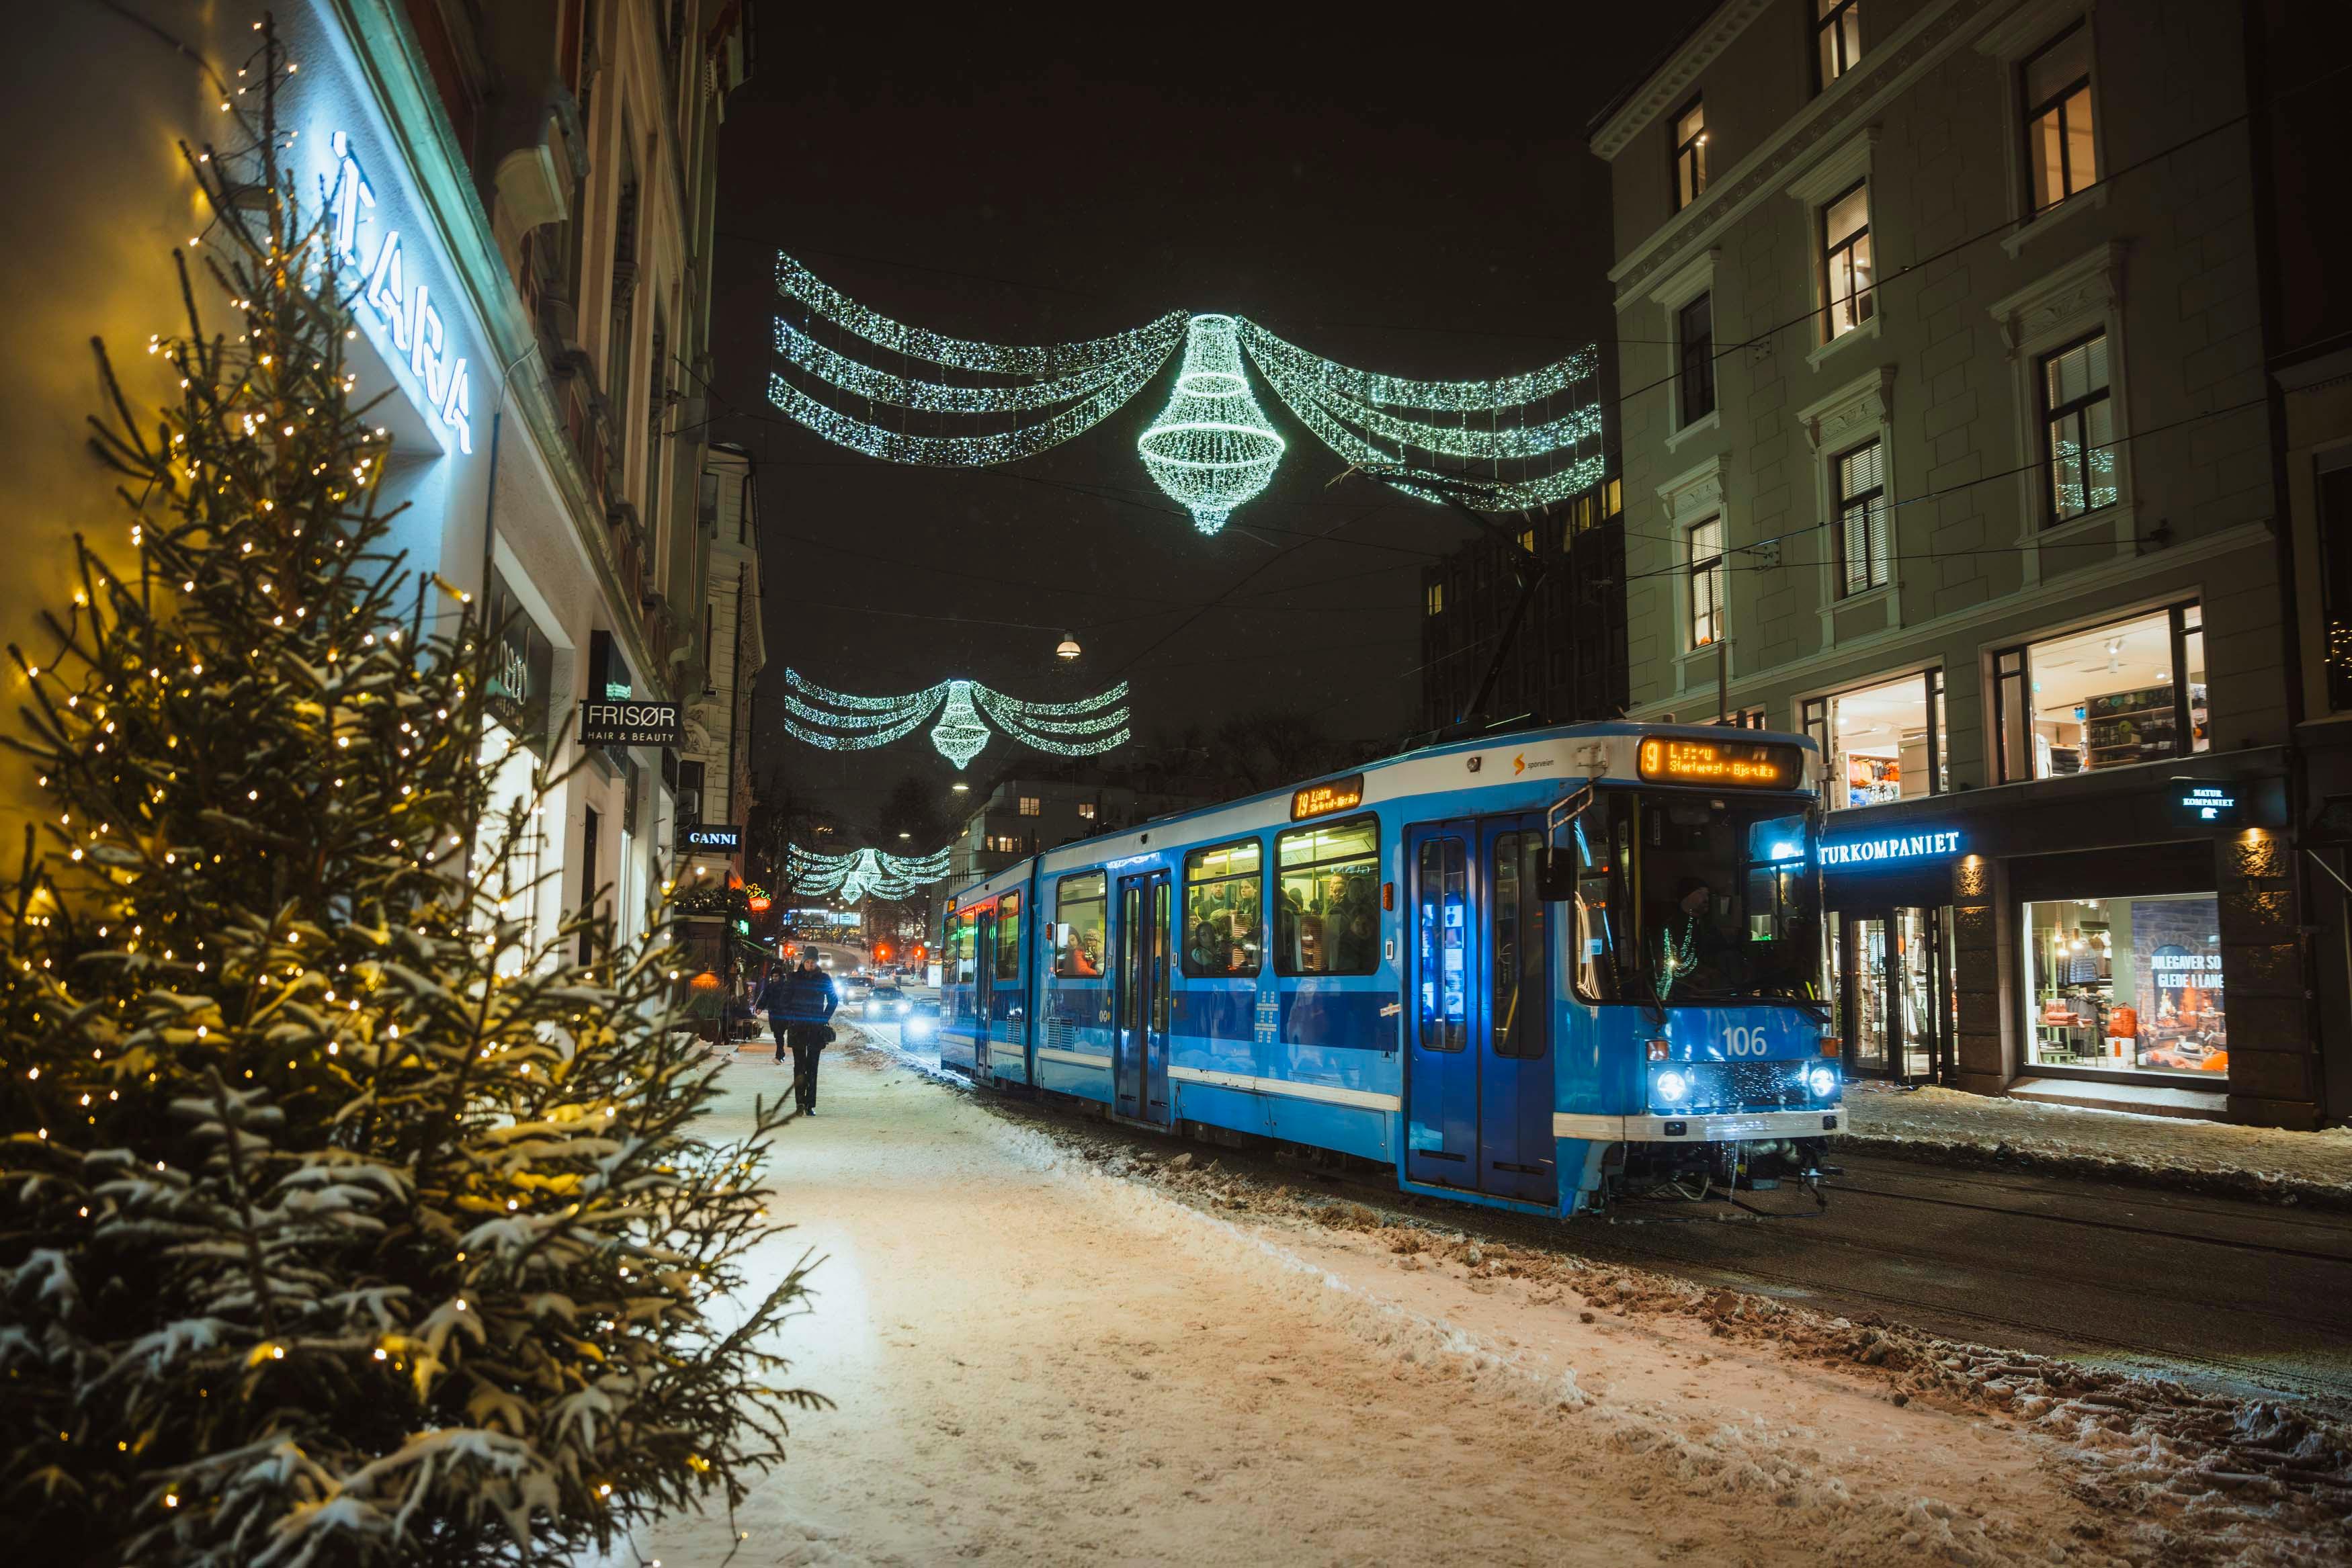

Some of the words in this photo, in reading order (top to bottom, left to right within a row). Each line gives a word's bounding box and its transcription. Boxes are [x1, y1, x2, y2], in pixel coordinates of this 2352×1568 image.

[589, 705, 675, 727] FRISØR
[587, 732, 614, 740] HAIR
[620, 732, 626, 740] &
[632, 733, 674, 742] BEAUTY
[2193, 789, 2223, 797] NATUR
[1296, 793, 1309, 817] 19
[2183, 798, 2234, 807] KOMPANIET
[689, 833, 737, 845] GANNI
[2150, 955, 2205, 969] JULEGAVER
[2158, 973, 2189, 988] GLEDE
[2191, 974, 2197, 988] I
[1722, 1027, 1767, 1056] 106
